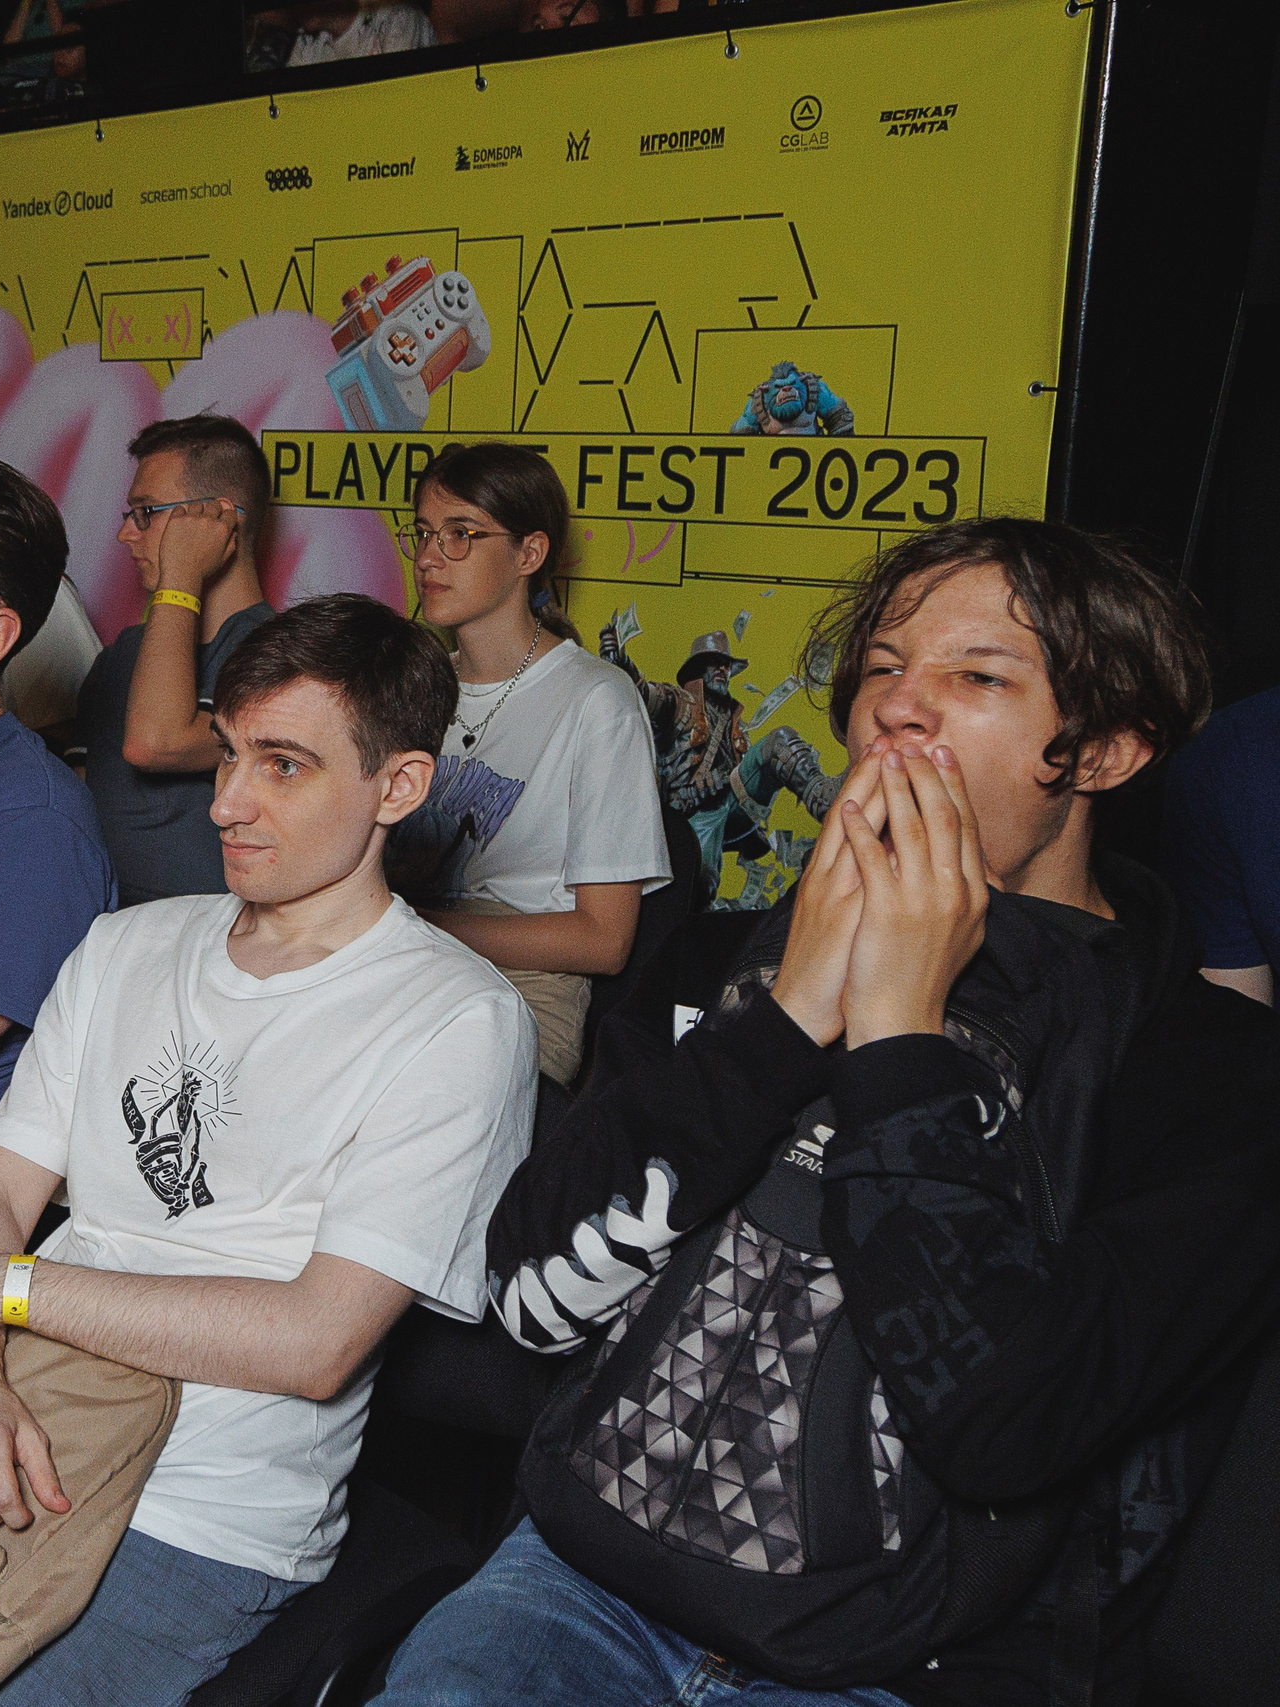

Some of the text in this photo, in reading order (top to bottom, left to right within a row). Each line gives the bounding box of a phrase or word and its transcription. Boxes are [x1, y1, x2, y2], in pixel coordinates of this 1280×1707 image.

[879, 103, 959, 123] ВСЯКАЯ
[639, 126, 725, 153] ИГРОПРОМ
[780, 131, 829, 147] CGLAB
[886, 119, 949, 137] АТМТА
[473, 145, 523, 163] БОМБОРА
[566, 128, 591, 162] XYZ
[347, 157, 416, 181] Panicon!
[2, 189, 114, 219] Yandex Cloud
[576, 444, 745, 516] FEST
[768, 447, 960, 523] 2023
[122, 1089, 139, 1128] RARE
